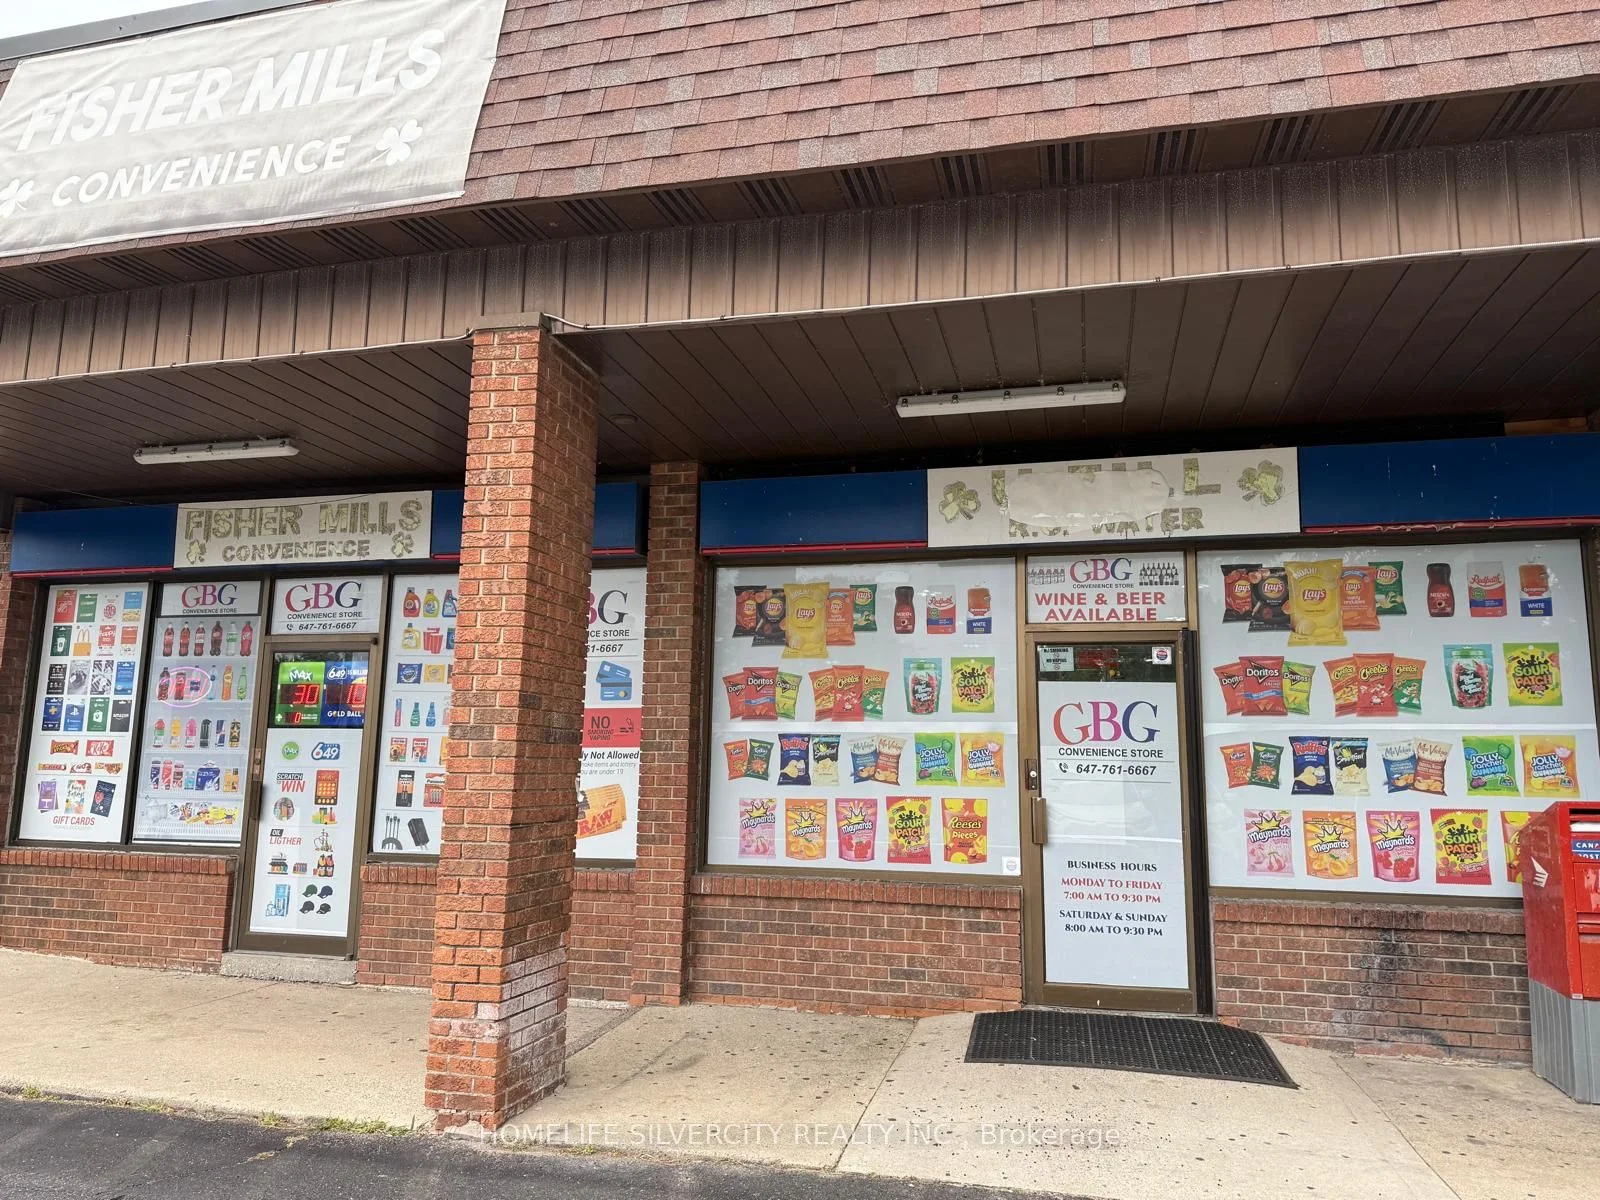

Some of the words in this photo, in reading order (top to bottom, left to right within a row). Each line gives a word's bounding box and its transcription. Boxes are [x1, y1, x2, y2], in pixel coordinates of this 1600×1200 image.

[16, 66, 232, 151] FISHER
[238, 28, 446, 115] MILLS
[50, 134, 352, 207] CONVENIENCE
[185, 504, 302, 541] FISHER
[319, 498, 423, 535] MILLS
[222, 539, 370, 562] CONVENIENCE
[1069, 557, 1133, 583] GBG
[181, 583, 238, 609] GBG
[285, 581, 362, 612] GBG
[1035, 593, 1087, 605] WINE
[1095, 593, 1108, 605] &
[1117, 592, 1166, 605] BEER
[287, 612, 337, 620] CONVENIENCE
[1045, 608, 1157, 621] AVAILABLE
[298, 622, 357, 630] 647-761-6667
[603, 629, 630, 637] STORE
[1247, 668, 1279, 677] Doritos
[1360, 665, 1389, 680] Cheetos
[1514, 664, 1549, 676] SOUR
[748, 677, 774, 686] Doritos
[958, 676, 986, 686] SOUR
[1515, 676, 1553, 687] PATCH
[293, 685, 320, 704] 30
[957, 686, 988, 696] PATCH
[591, 716, 611, 729] NO
[1053, 700, 1160, 745] GBG
[590, 751, 605, 759] Not
[606, 750, 639, 759] Allowed
[920, 747, 942, 757] JOLLY
[968, 748, 990, 759] JOLLY
[1059, 747, 1127, 757] CONVENIENCE
[1131, 748, 1163, 758] STORE
[1471, 753, 1499, 765] JOLLY
[1473, 759, 1503, 769] rancher
[1532, 756, 1559, 767] JOLLY
[1076, 764, 1156, 775] 647-761-6667
[1472, 765, 1507, 777] GUMMIES
[1534, 762, 1562, 771] rancher
[276, 772, 303, 781] SCRATCH
[281, 780, 306, 793] WIN
[53, 816, 70, 825] GIFT
[70, 816, 96, 826] CARDS
[579, 808, 613, 836] RAW
[896, 819, 925, 828] SOUR
[896, 828, 925, 837] PATCH
[269, 836, 302, 846] LIGTHER
[1445, 833, 1479, 844] SOUR
[1446, 844, 1481, 853] PATCH
[1067, 861, 1116, 870] BUSINESS
[1121, 863, 1157, 872] HOURS
[1061, 877, 1105, 887] MONDAY
[1108, 879, 1123, 888] TO
[1126, 880, 1162, 890] FRIDAY
[1064, 891, 1084, 900] 7:00
[1087, 893, 1102, 901] AM
[1105, 893, 1119, 901] TO
[1122, 894, 1143, 903] 9:30
[1146, 895, 1161, 903] PM
[1059, 909, 1112, 920] SATURDAY
[1115, 912, 1123, 920] &
[1125, 913, 1167, 922] SUNDAY
[1065, 923, 1086, 932] 8:00
[1088, 925, 1104, 933] AM
[1106, 925, 1121, 934] TO
[1123, 926, 1144, 935] 9:30
[1147, 927, 1163, 936] PM
